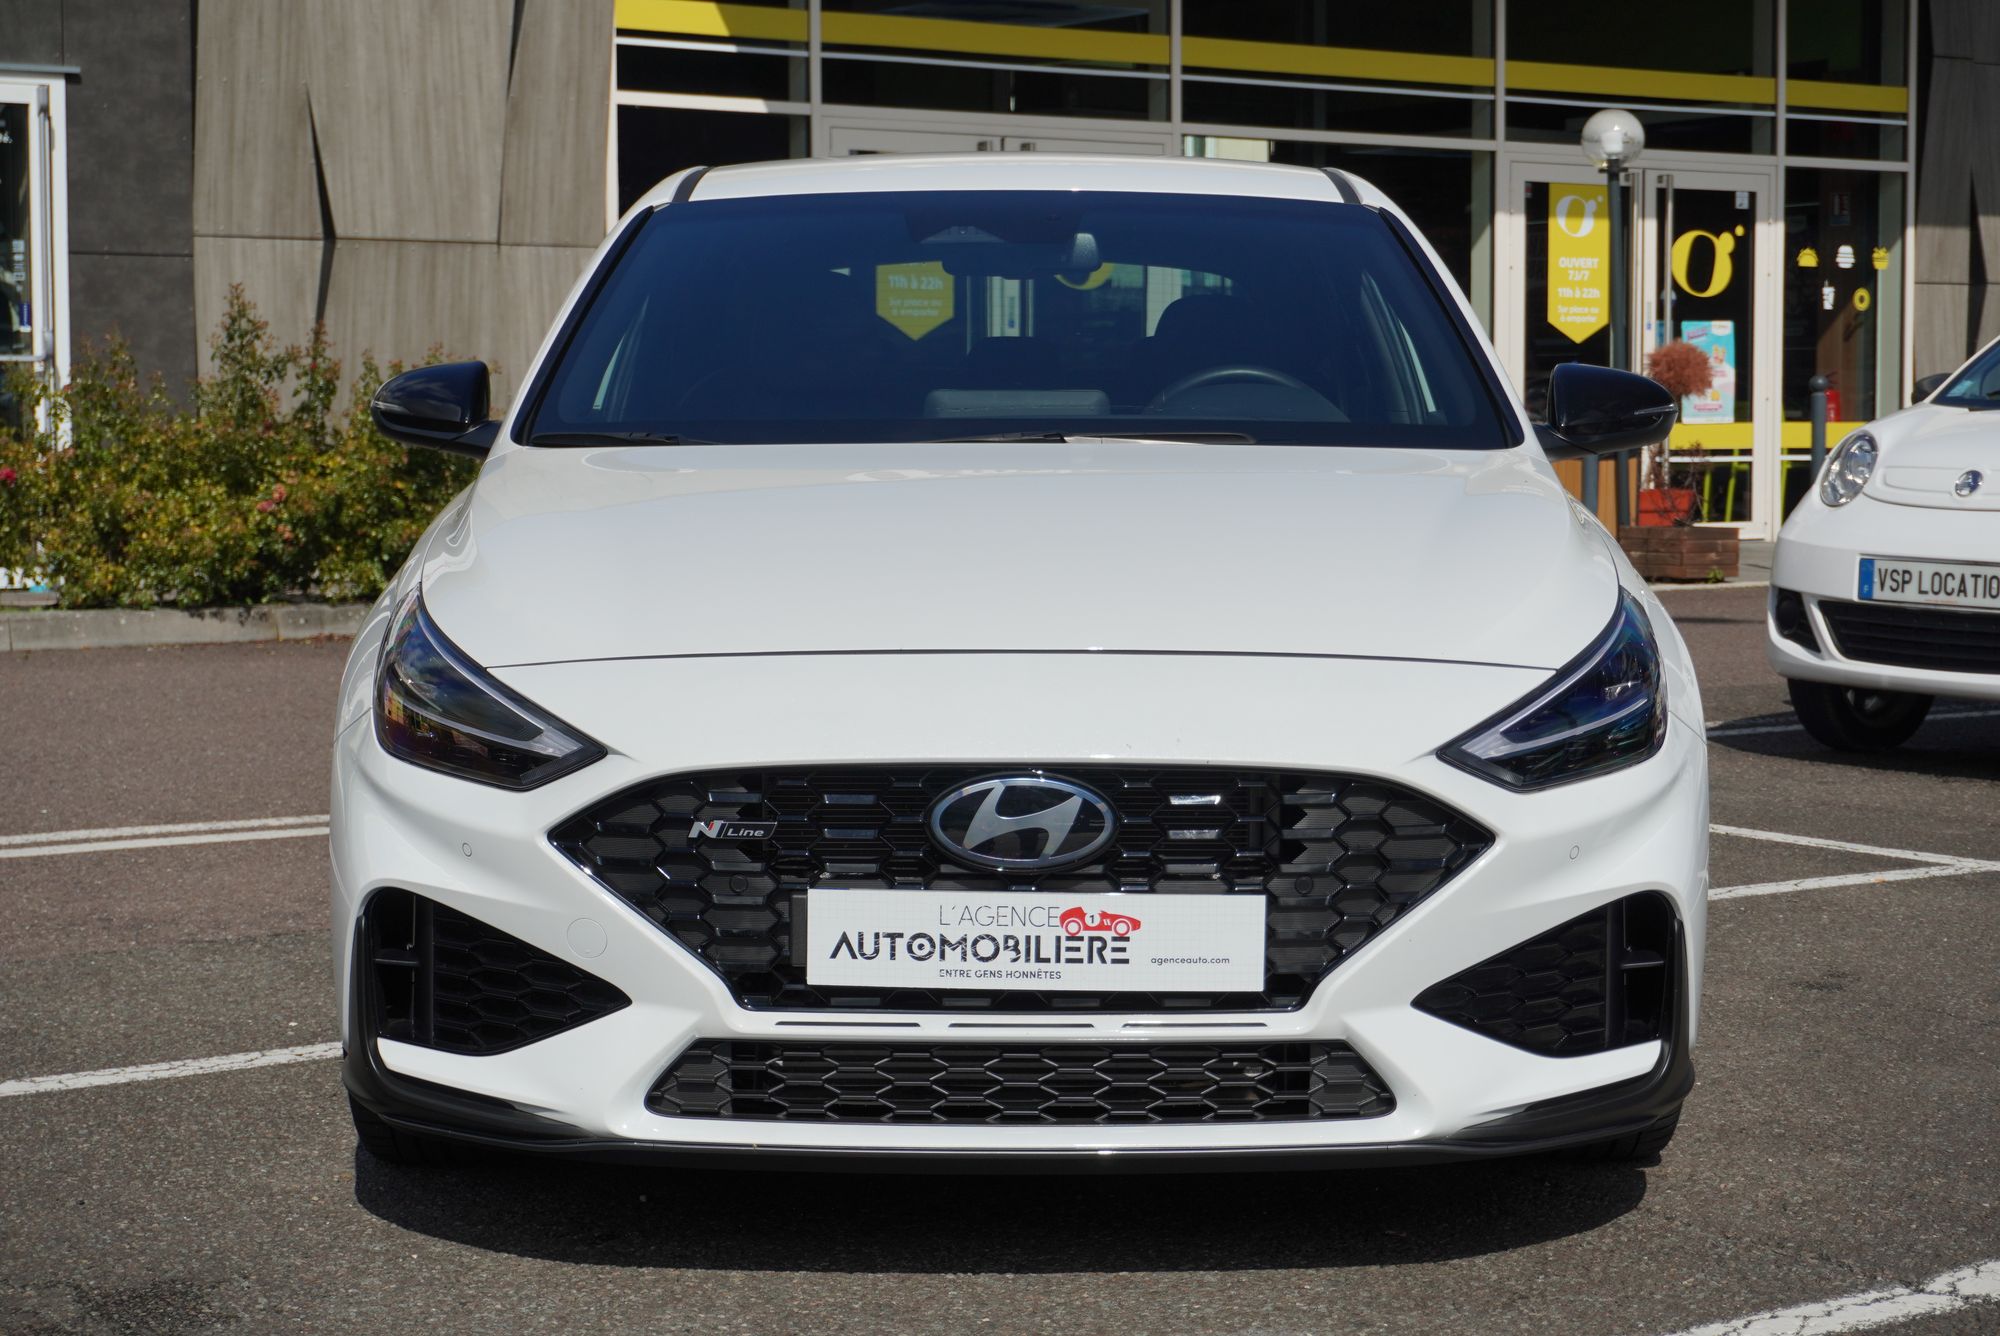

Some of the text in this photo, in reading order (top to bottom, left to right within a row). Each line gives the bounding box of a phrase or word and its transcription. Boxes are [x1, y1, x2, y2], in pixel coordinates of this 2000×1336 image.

[1558, 256, 1600, 269] OUVERT
[1557, 287, 1573, 298] 11h
[1583, 287, 1601, 298] 22h
[1879, 568, 1912, 593] VSP
[727, 828, 764, 837] Line
[939, 905, 1060, 928] L'AGENCE
[1151, 956, 1230, 966] agenceauto.com
[939, 967, 1062, 980] ENTRE GENS HONNÊTES
